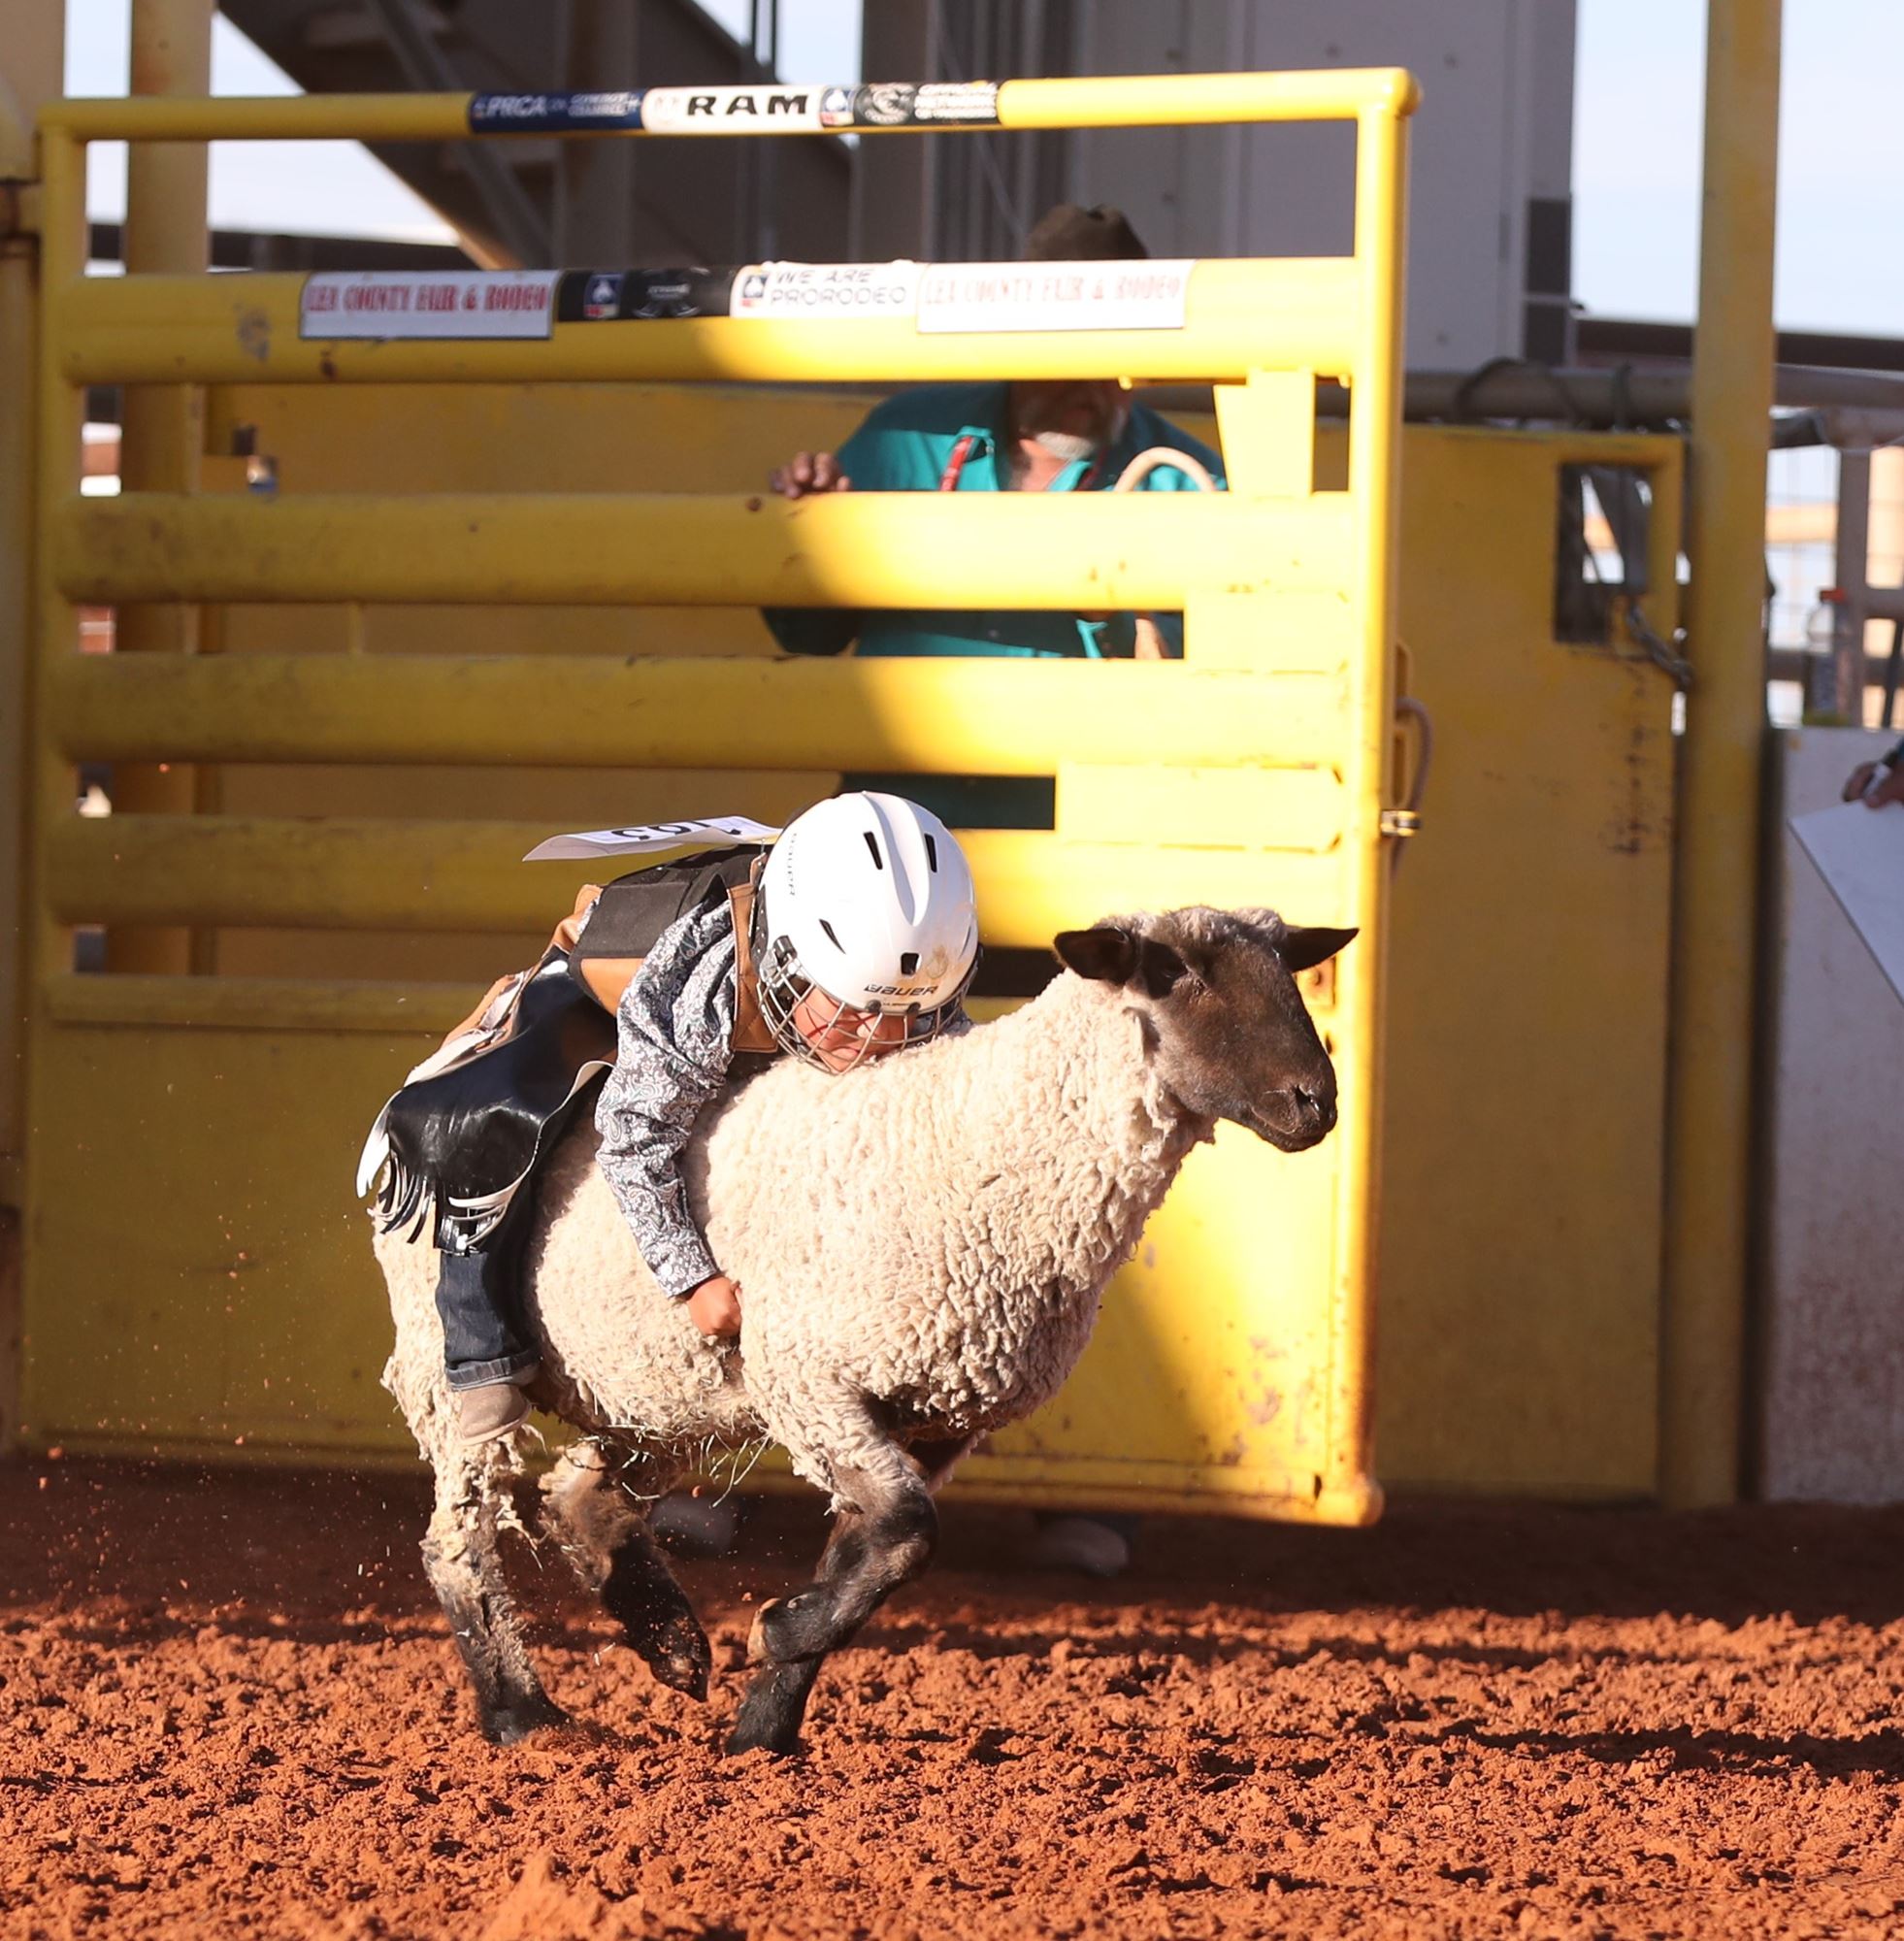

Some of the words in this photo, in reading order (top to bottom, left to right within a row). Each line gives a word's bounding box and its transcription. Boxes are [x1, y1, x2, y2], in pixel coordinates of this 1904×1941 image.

[486, 95, 547, 117] PRCA
[687, 94, 808, 115] RAM
[777, 271, 815, 283] WE
[825, 270, 873, 282] ARE
[344, 285, 410, 311] COUNTY
[416, 285, 458, 312] FAIR
[464, 285, 480, 311] &
[485, 285, 547, 311] RODEO
[771, 286, 906, 306] PRORODEO
[864, 983, 938, 997] BAUER
